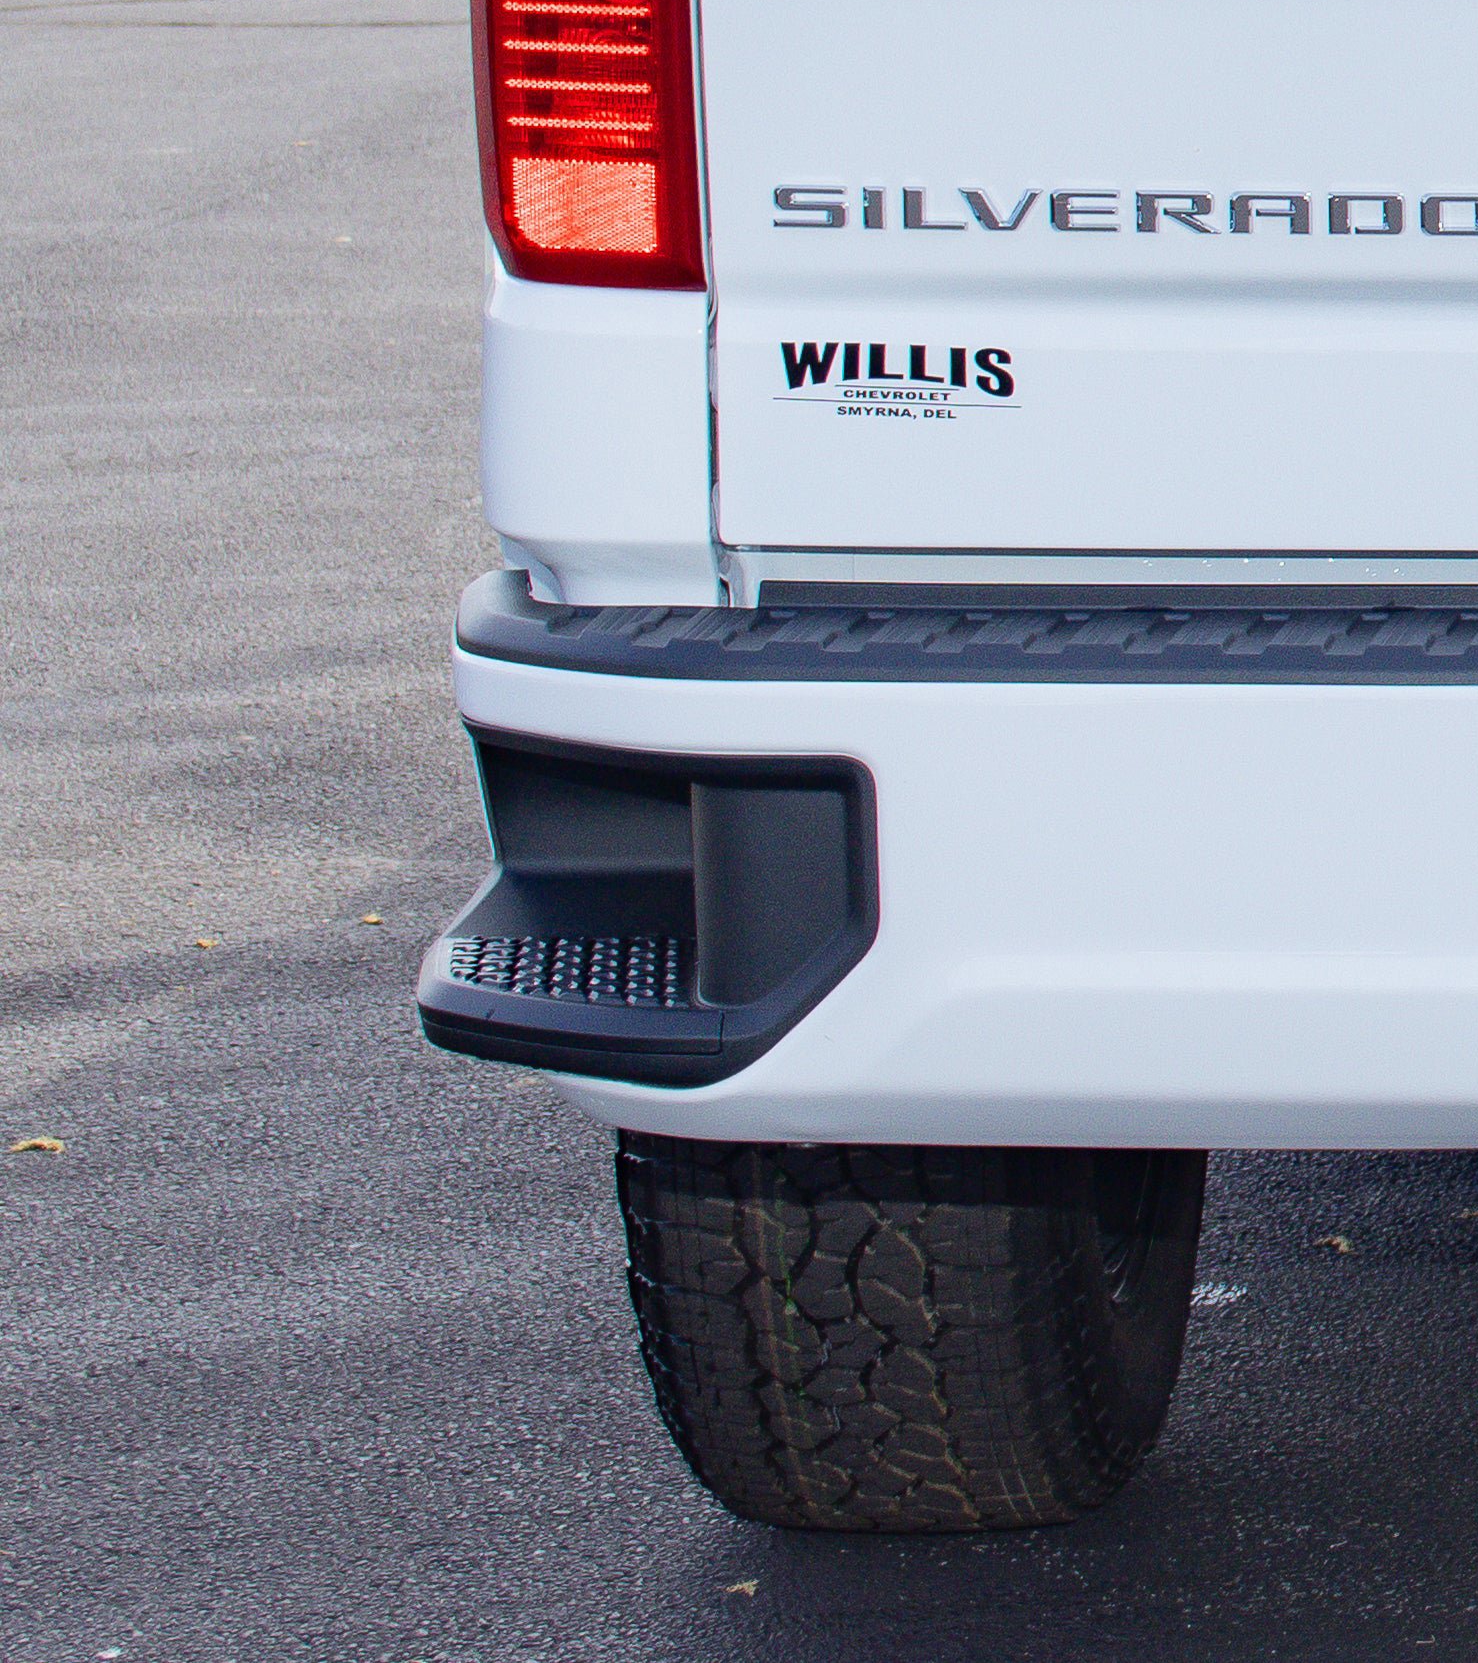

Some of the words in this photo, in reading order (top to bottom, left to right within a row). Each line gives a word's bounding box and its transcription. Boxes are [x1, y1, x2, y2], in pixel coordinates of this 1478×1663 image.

[780, 341, 1015, 398] WILLIS
[843, 389, 952, 402] CHEVROLET
[837, 405, 918, 420] SMYRNA,
[923, 408, 957, 420] DEL
